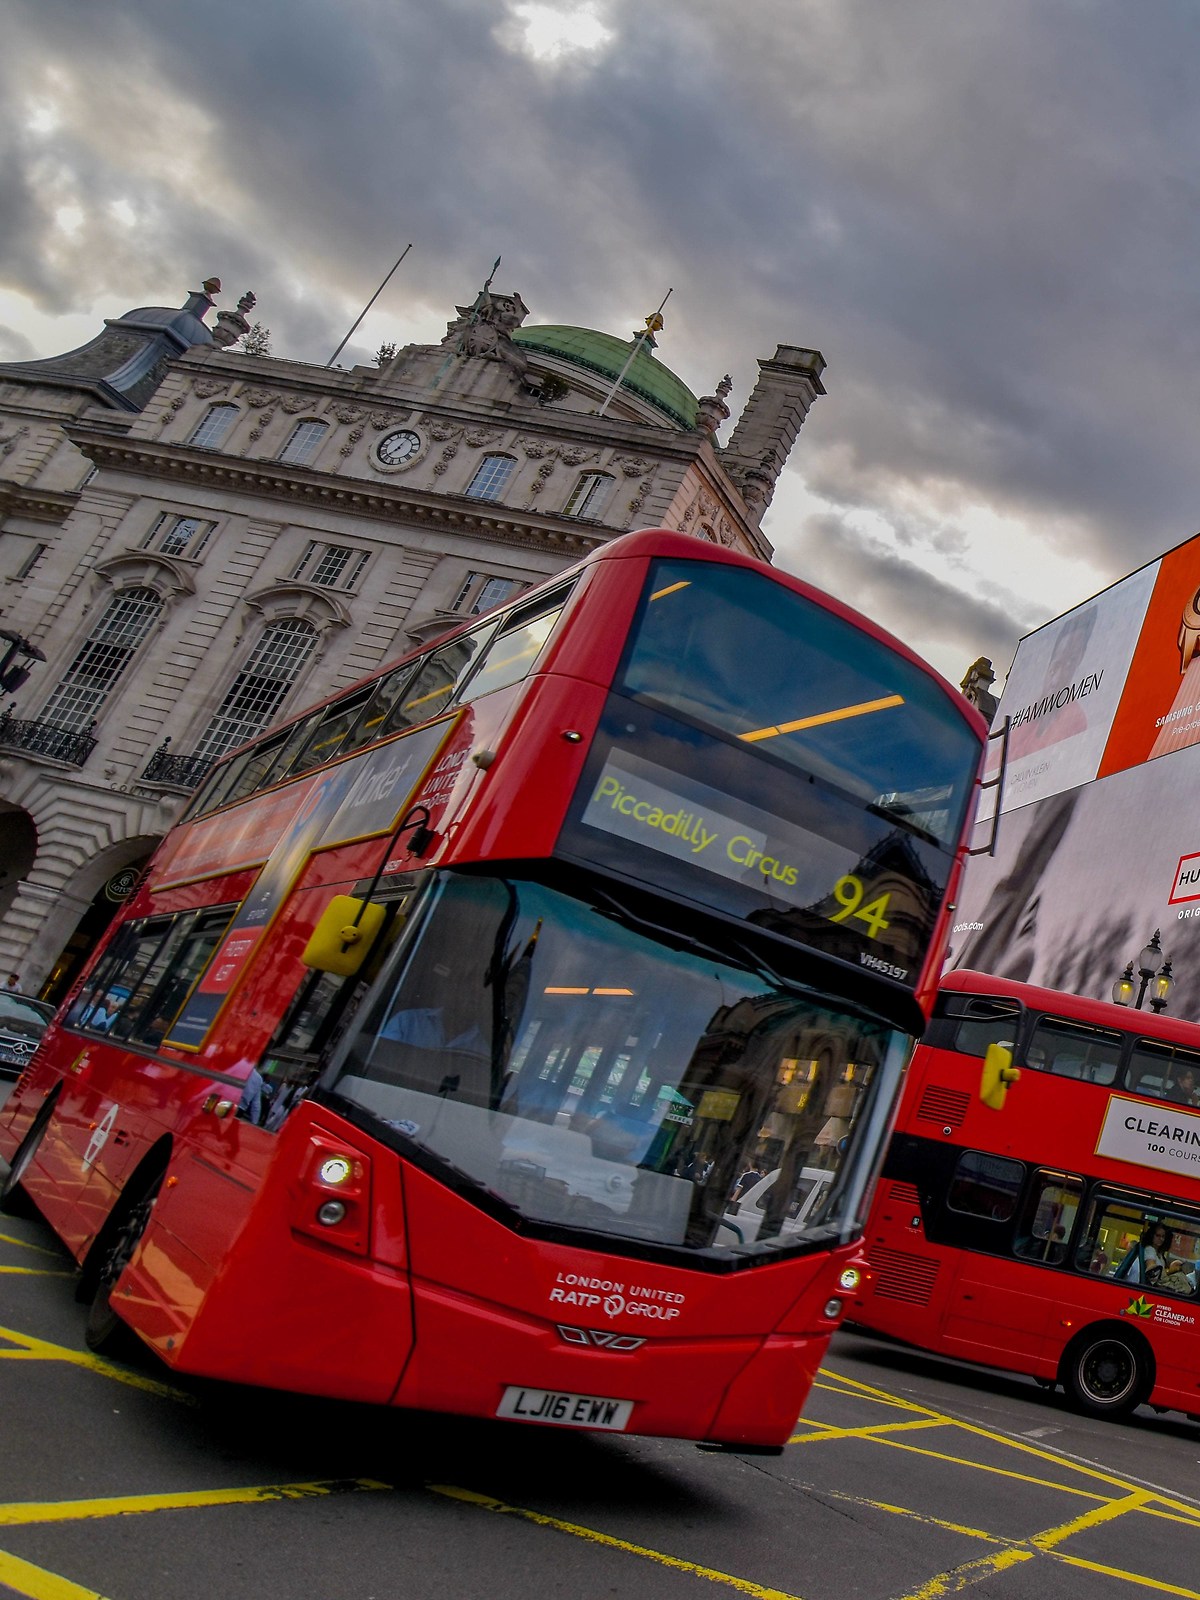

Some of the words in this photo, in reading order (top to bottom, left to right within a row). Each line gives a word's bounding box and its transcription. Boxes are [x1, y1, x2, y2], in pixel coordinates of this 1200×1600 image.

[1009, 669, 1105, 731] #IAMWOMEN
[1155, 705, 1193, 728] SAMSUNG
[594, 776, 718, 853] Piccadilly
[726, 835, 799, 886] Circus
[828, 874, 891, 939] 94
[860, 952, 909, 980] VH45197
[1146, 1142, 1165, 1154] 100
[556, 1272, 625, 1294] LONDON
[629, 1285, 686, 1304] UNITED
[549, 1287, 601, 1308] RATP
[625, 1301, 681, 1321] GROUP
[1156, 1304, 1172, 1312] HYBRID
[1162, 1318, 1181, 1326] LONDON
[513, 1390, 571, 1419] LJ16
